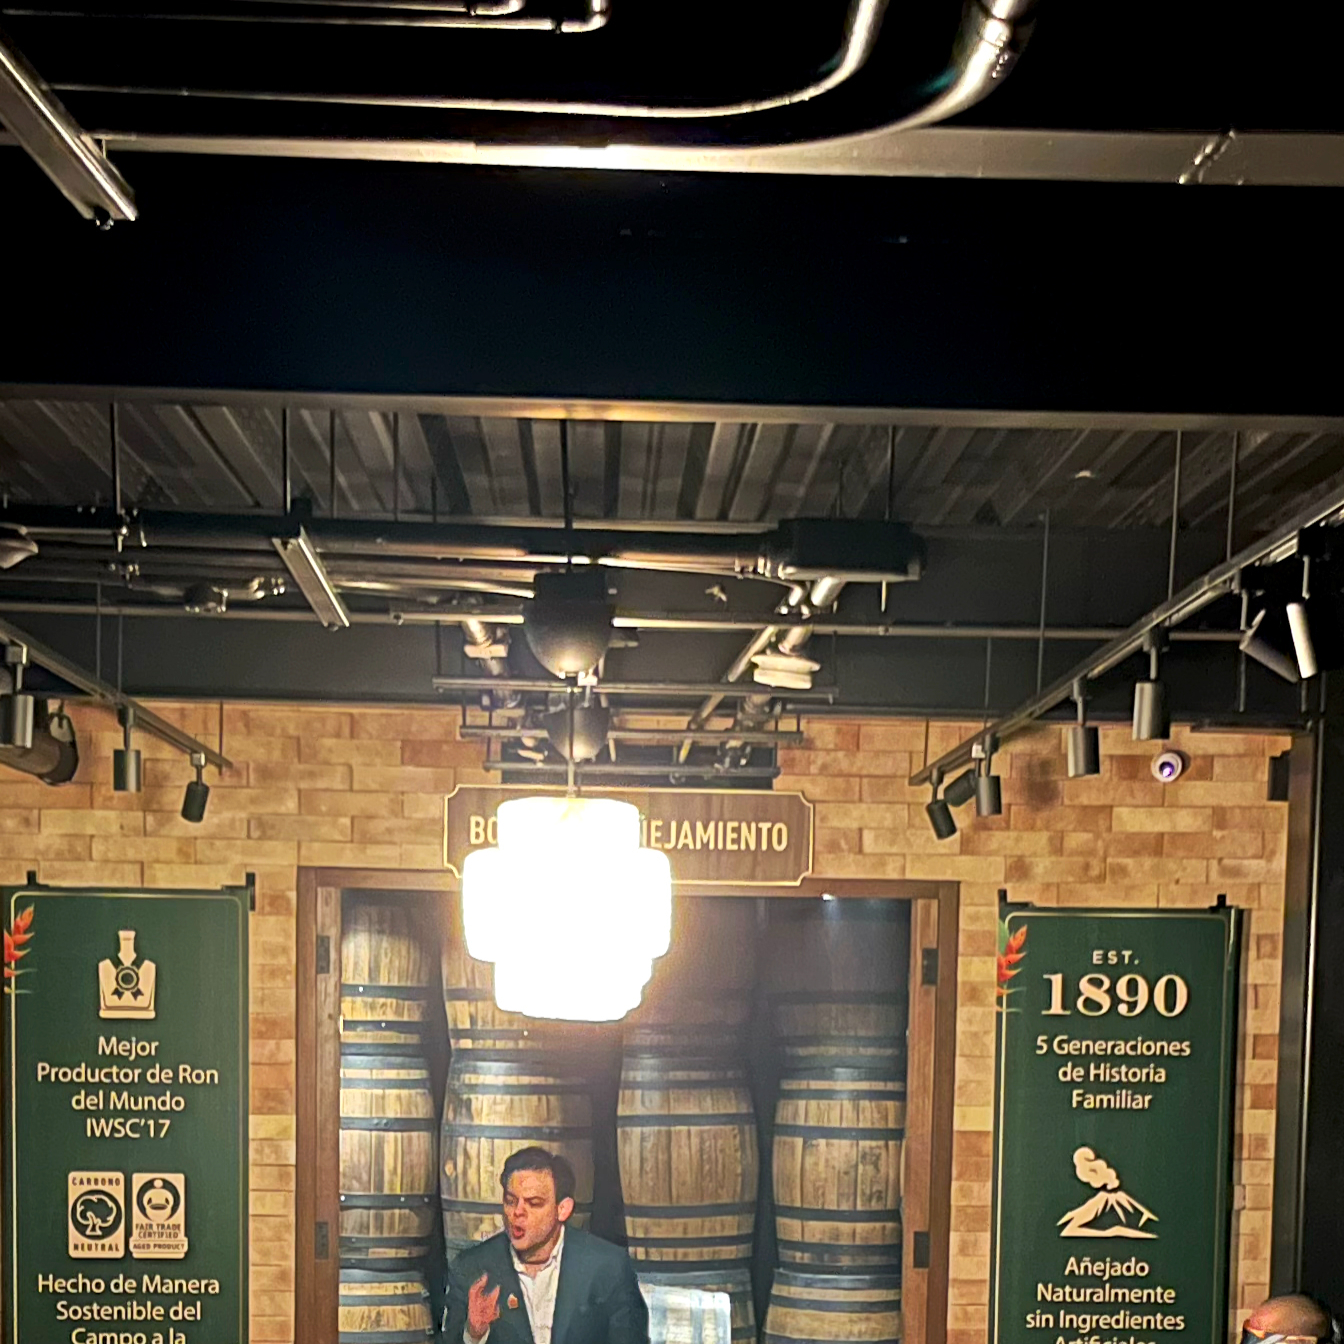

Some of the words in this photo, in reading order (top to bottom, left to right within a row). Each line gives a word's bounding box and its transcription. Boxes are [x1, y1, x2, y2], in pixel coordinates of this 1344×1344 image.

[1092, 950, 1140, 965] EST.
[1041, 973, 1188, 1017] 1890
[98, 1036, 159, 1061] Mejor
[1036, 1035, 1048, 1055] 5
[1053, 1035, 1191, 1056] Generaciones
[37, 1062, 141, 1083] Productor
[146, 1063, 174, 1084] de
[178, 1064, 219, 1085] Ron
[1058, 1061, 1085, 1082] de
[1089, 1062, 1166, 1083] Historia
[71, 1089, 104, 1110] del
[109, 1090, 185, 1112] Mundo
[1072, 1089, 1152, 1109] Familiar
[86, 1118, 171, 1139] IWSC'17
[72, 1177, 121, 1187] CARBONO
[73, 1243, 120, 1252] NEUTRAL
[1064, 1256, 1150, 1281] Añejado
[37, 1273, 105, 1294] Hecho
[109, 1274, 137, 1294] de
[142, 1274, 220, 1294] Manera
[1037, 1283, 1176, 1304] Naturalmente
[56, 1300, 165, 1321] Sostenible
[169, 1301, 201, 1321] del
[1025, 1310, 1054, 1329] sin
[1060, 1310, 1185, 1334] Ingredientes
